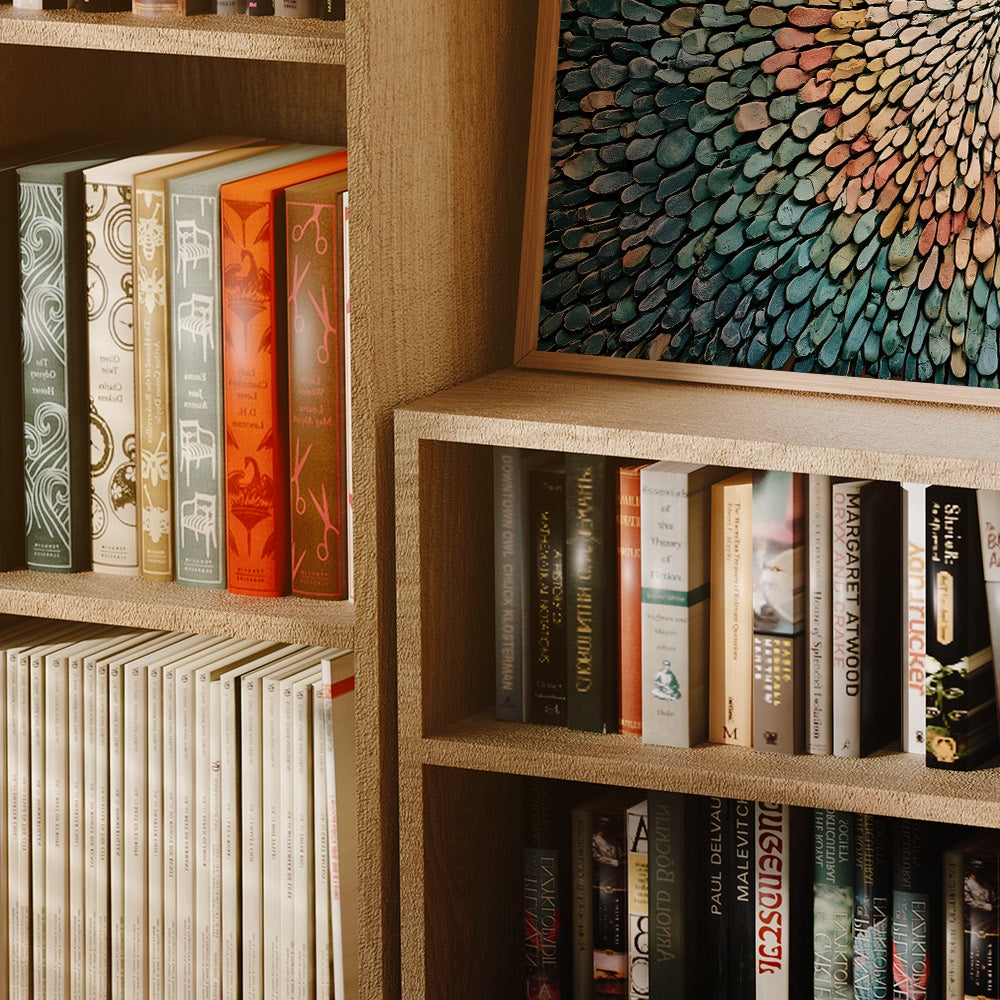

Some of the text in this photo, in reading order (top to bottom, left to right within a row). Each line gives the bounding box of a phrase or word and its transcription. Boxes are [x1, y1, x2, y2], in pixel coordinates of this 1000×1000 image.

[502, 454, 514, 692] DOWNTOWN OWL CHUCK KLOSTERMAN
[651, 537, 682, 550] Theory
[833, 491, 846, 669] ORYX AND CRAKE
[846, 492, 861, 697] MARGARET ATWOOD
[710, 871, 722, 915] PAUL
